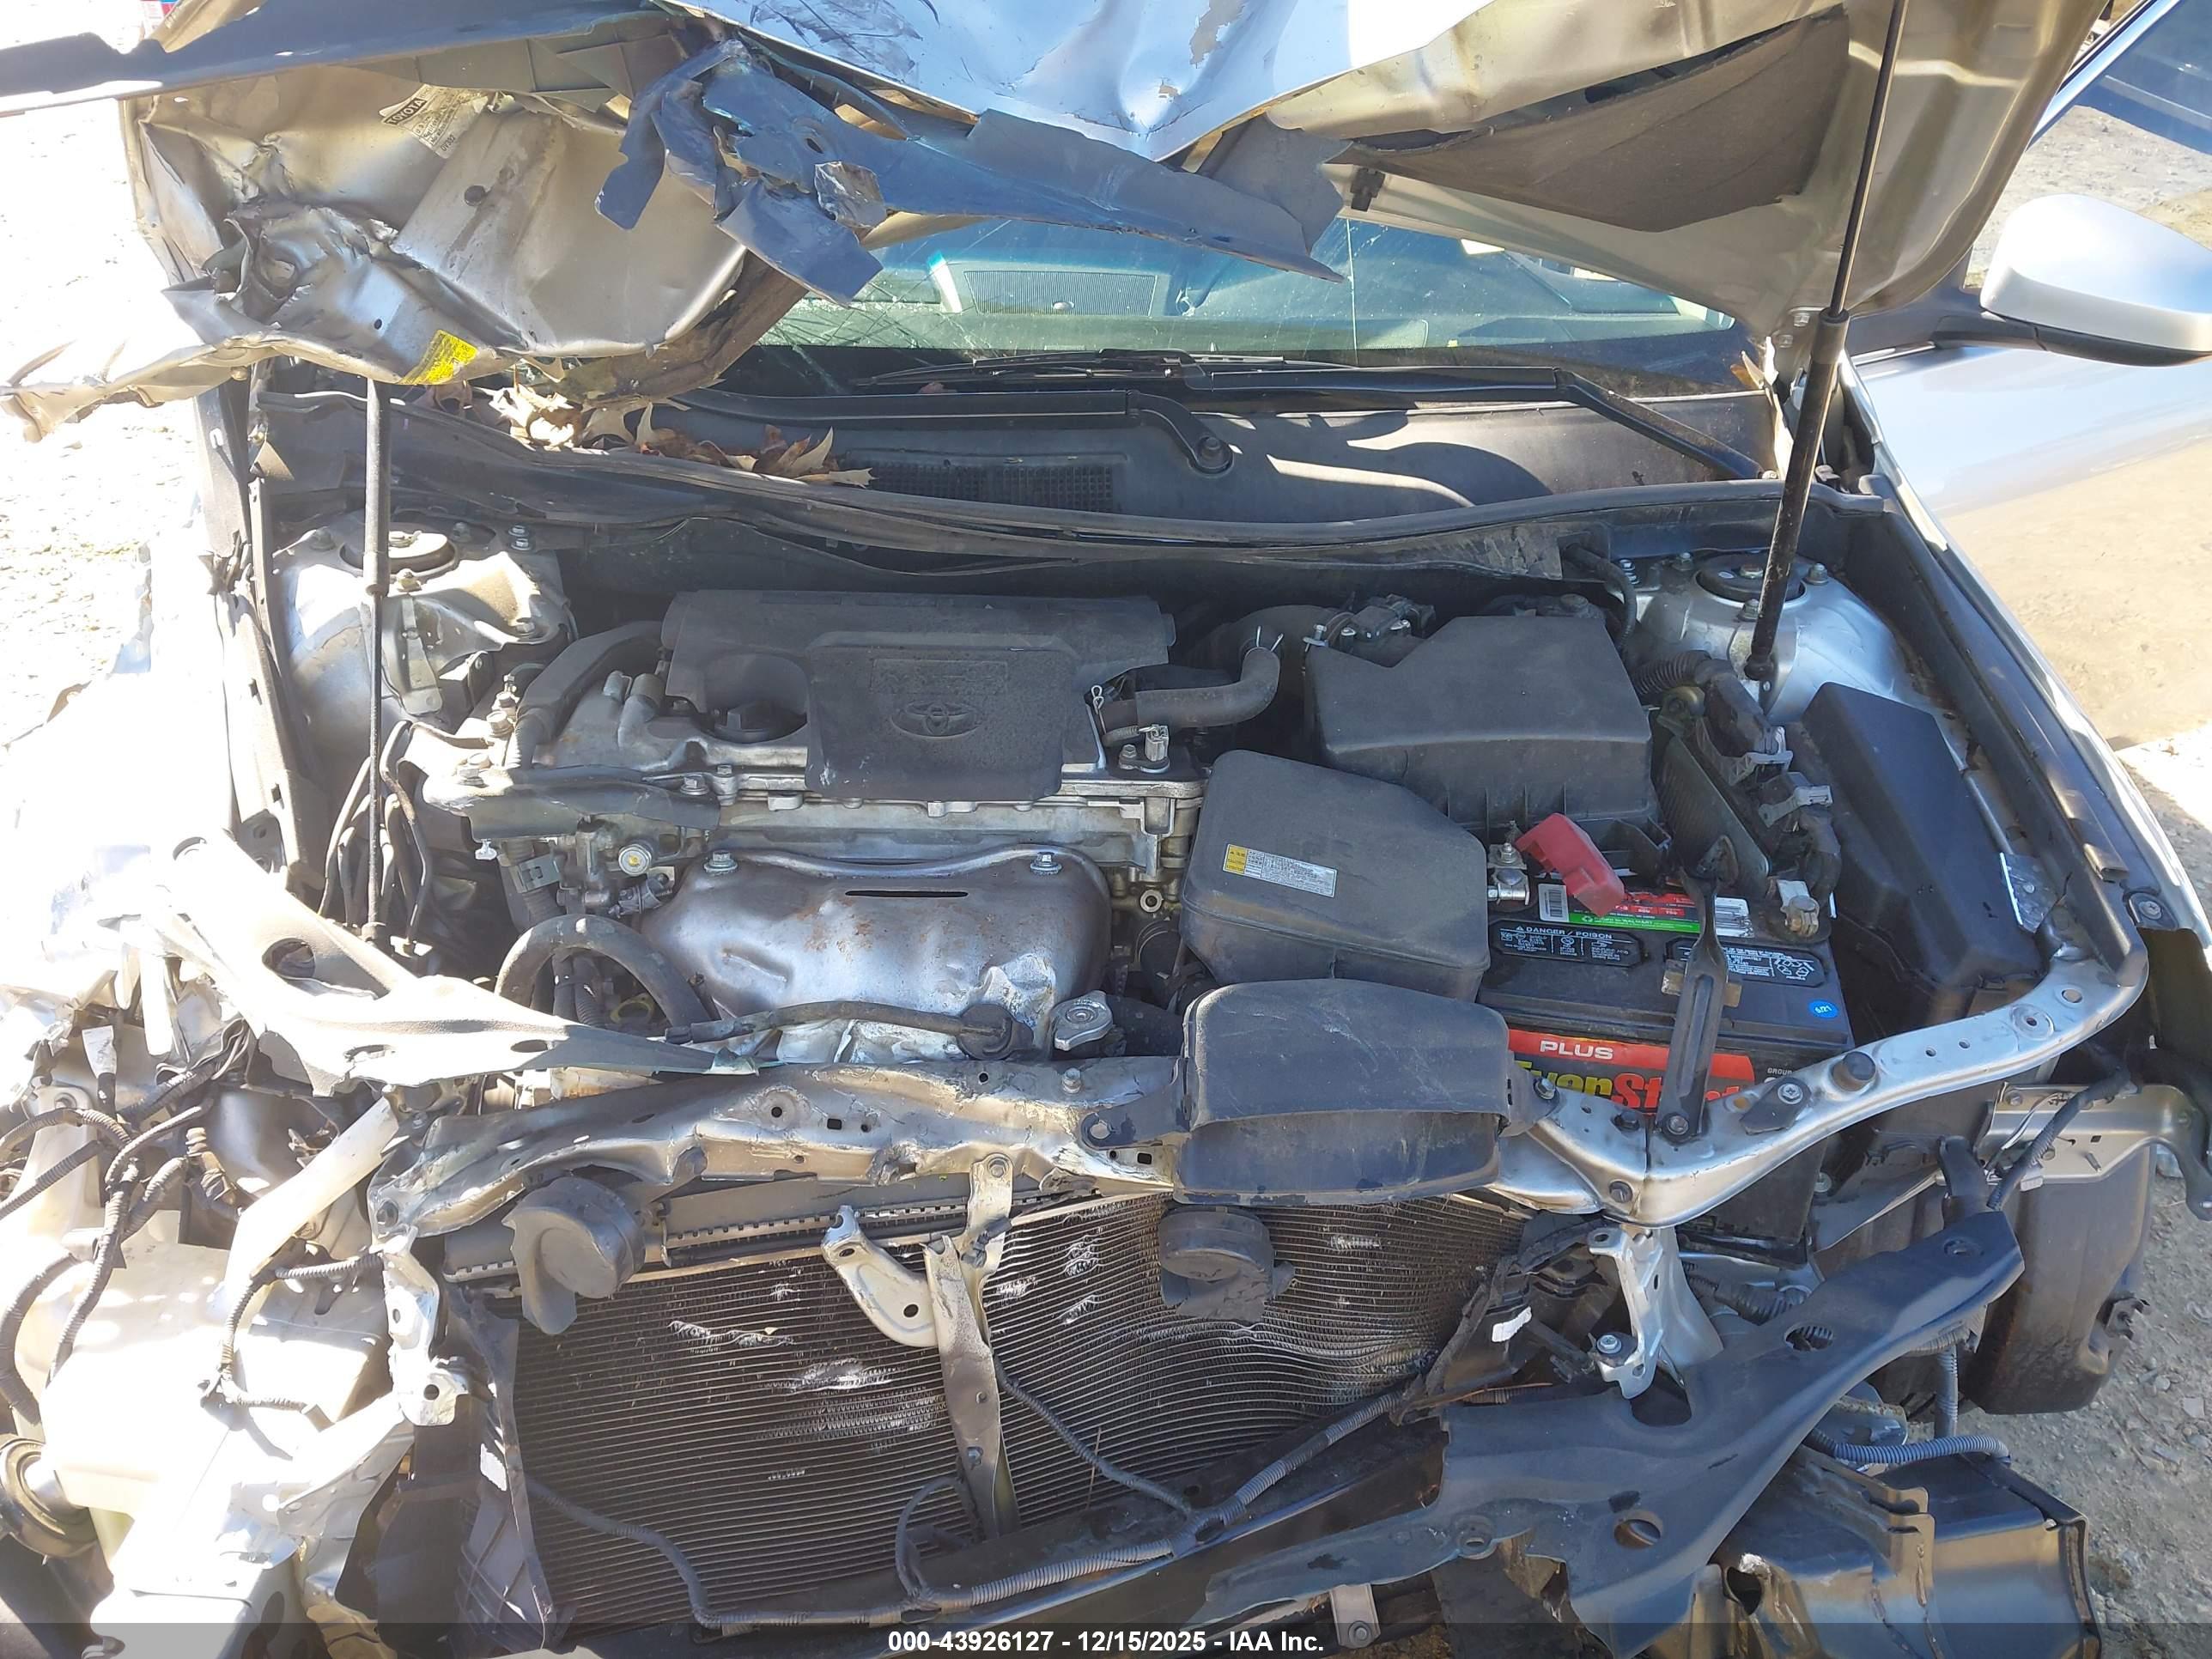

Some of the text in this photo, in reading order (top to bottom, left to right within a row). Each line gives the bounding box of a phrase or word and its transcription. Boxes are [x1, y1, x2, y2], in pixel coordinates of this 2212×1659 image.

[386, 100, 426, 123] TOYOTA
[1526, 927, 1565, 935] DANGER
[1576, 931, 1613, 939] POISON
[1540, 1040, 1613, 1060] PLUS
